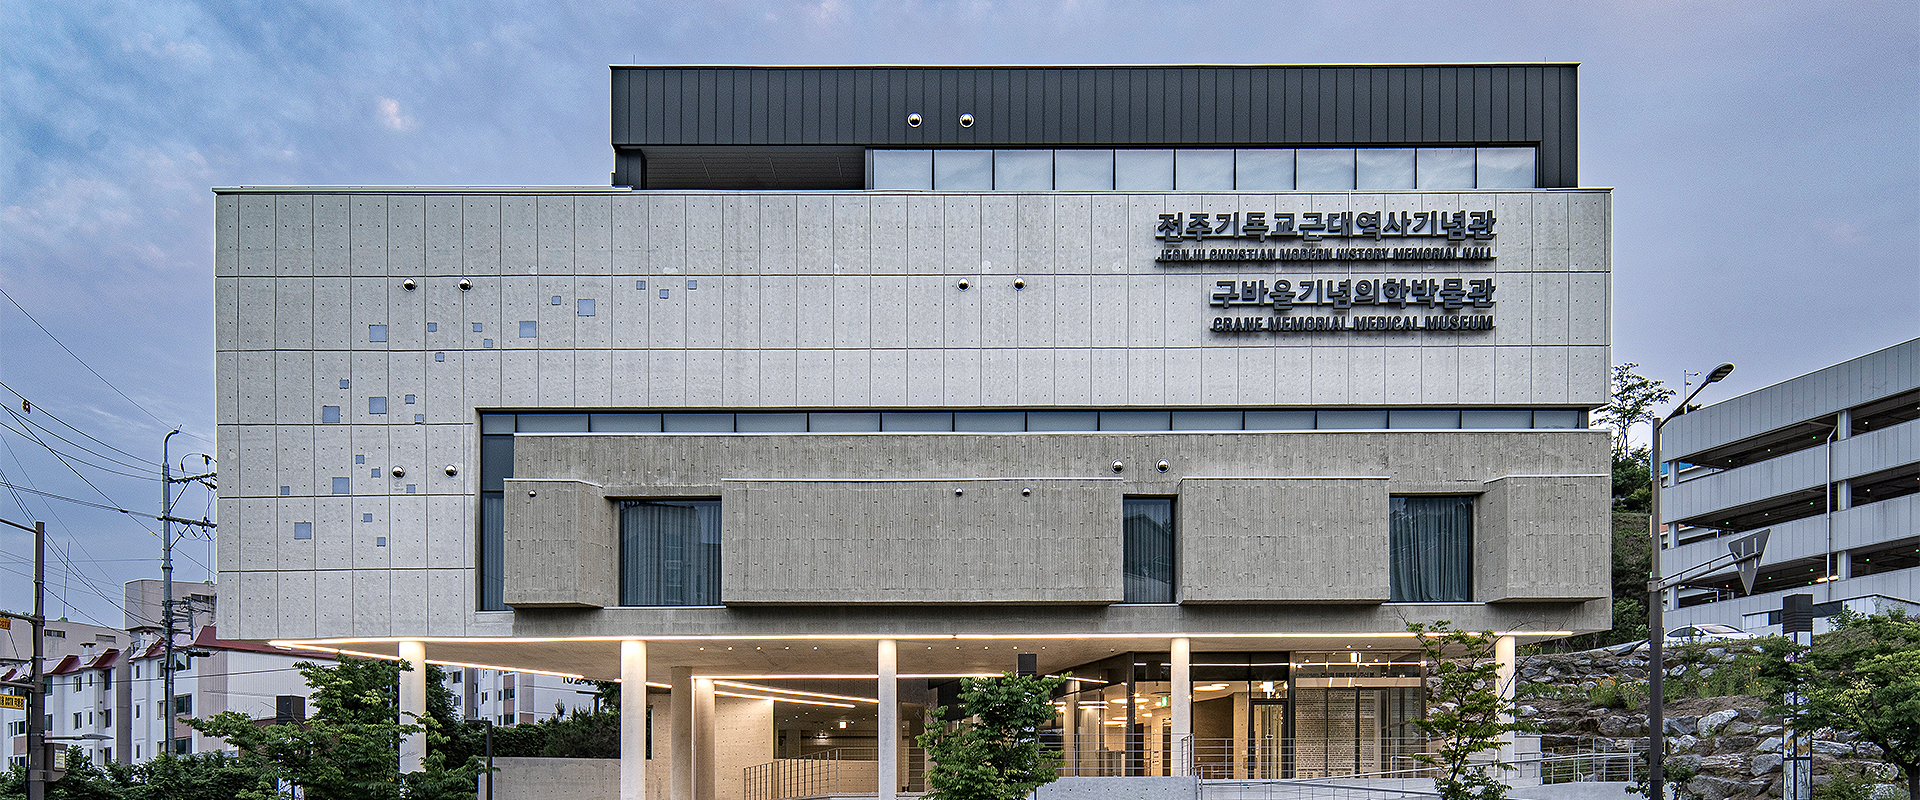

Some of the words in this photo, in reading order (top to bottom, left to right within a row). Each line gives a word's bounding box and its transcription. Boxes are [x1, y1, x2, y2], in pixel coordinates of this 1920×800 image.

[1157, 210, 1496, 242] 전주기독교근대역사기념관
[1157, 248, 1206, 262] JEONJU
[1209, 248, 1276, 262] CHRISTIAN
[1280, 247, 1333, 261] MODERN
[1336, 247, 1390, 261] HISTORY
[1393, 247, 1459, 260] MEMORIAL
[1462, 246, 1493, 260] HALL
[1213, 279, 1496, 310] 구바울기념의학박물관
[1213, 317, 1263, 332] CRANE
[1268, 316, 1349, 332] MEMORIAL
[1353, 316, 1420, 331] MEDICAL
[1425, 315, 1494, 331] MUSEUM
